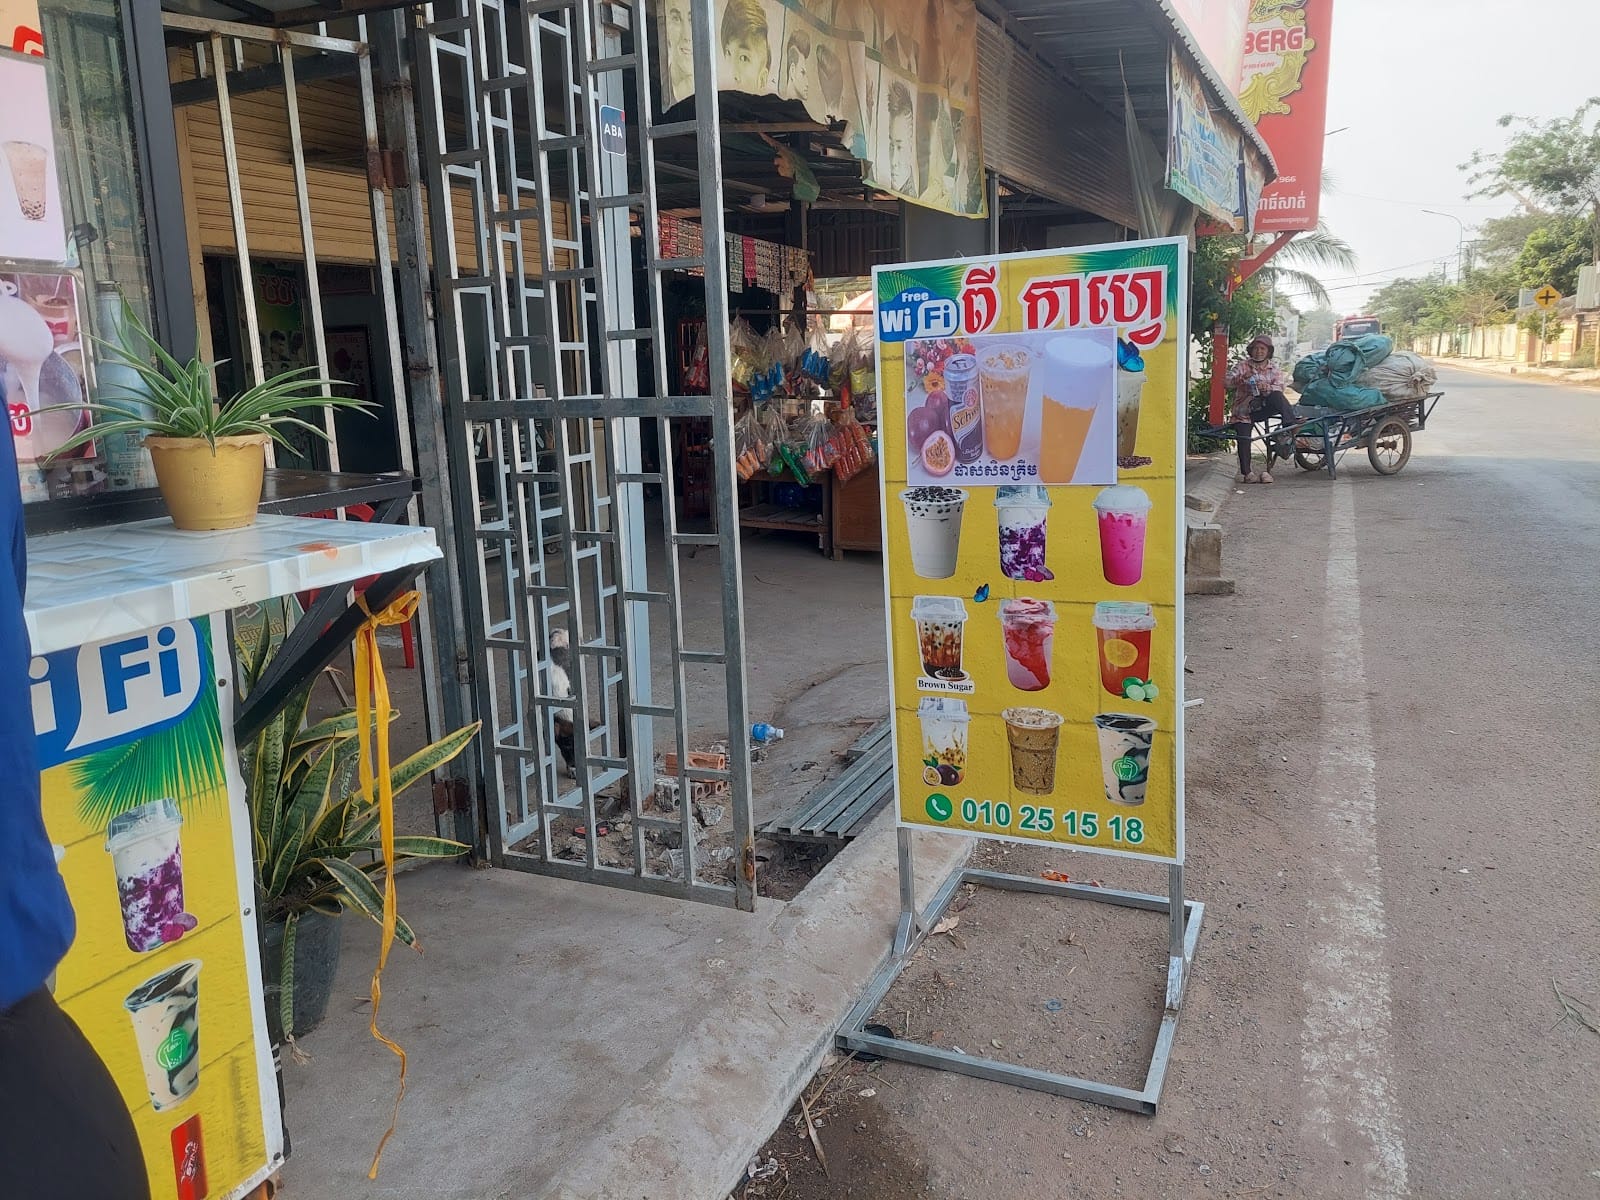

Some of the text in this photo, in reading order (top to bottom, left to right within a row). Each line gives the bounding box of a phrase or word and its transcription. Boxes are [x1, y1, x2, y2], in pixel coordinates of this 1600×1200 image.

[604, 123, 623, 139] ABA
[902, 292, 929, 302] Free
[962, 265, 996, 334] ពី
[918, 680, 973, 692] Brown Sugar
[962, 799, 1143, 843] 010 25 15 18
